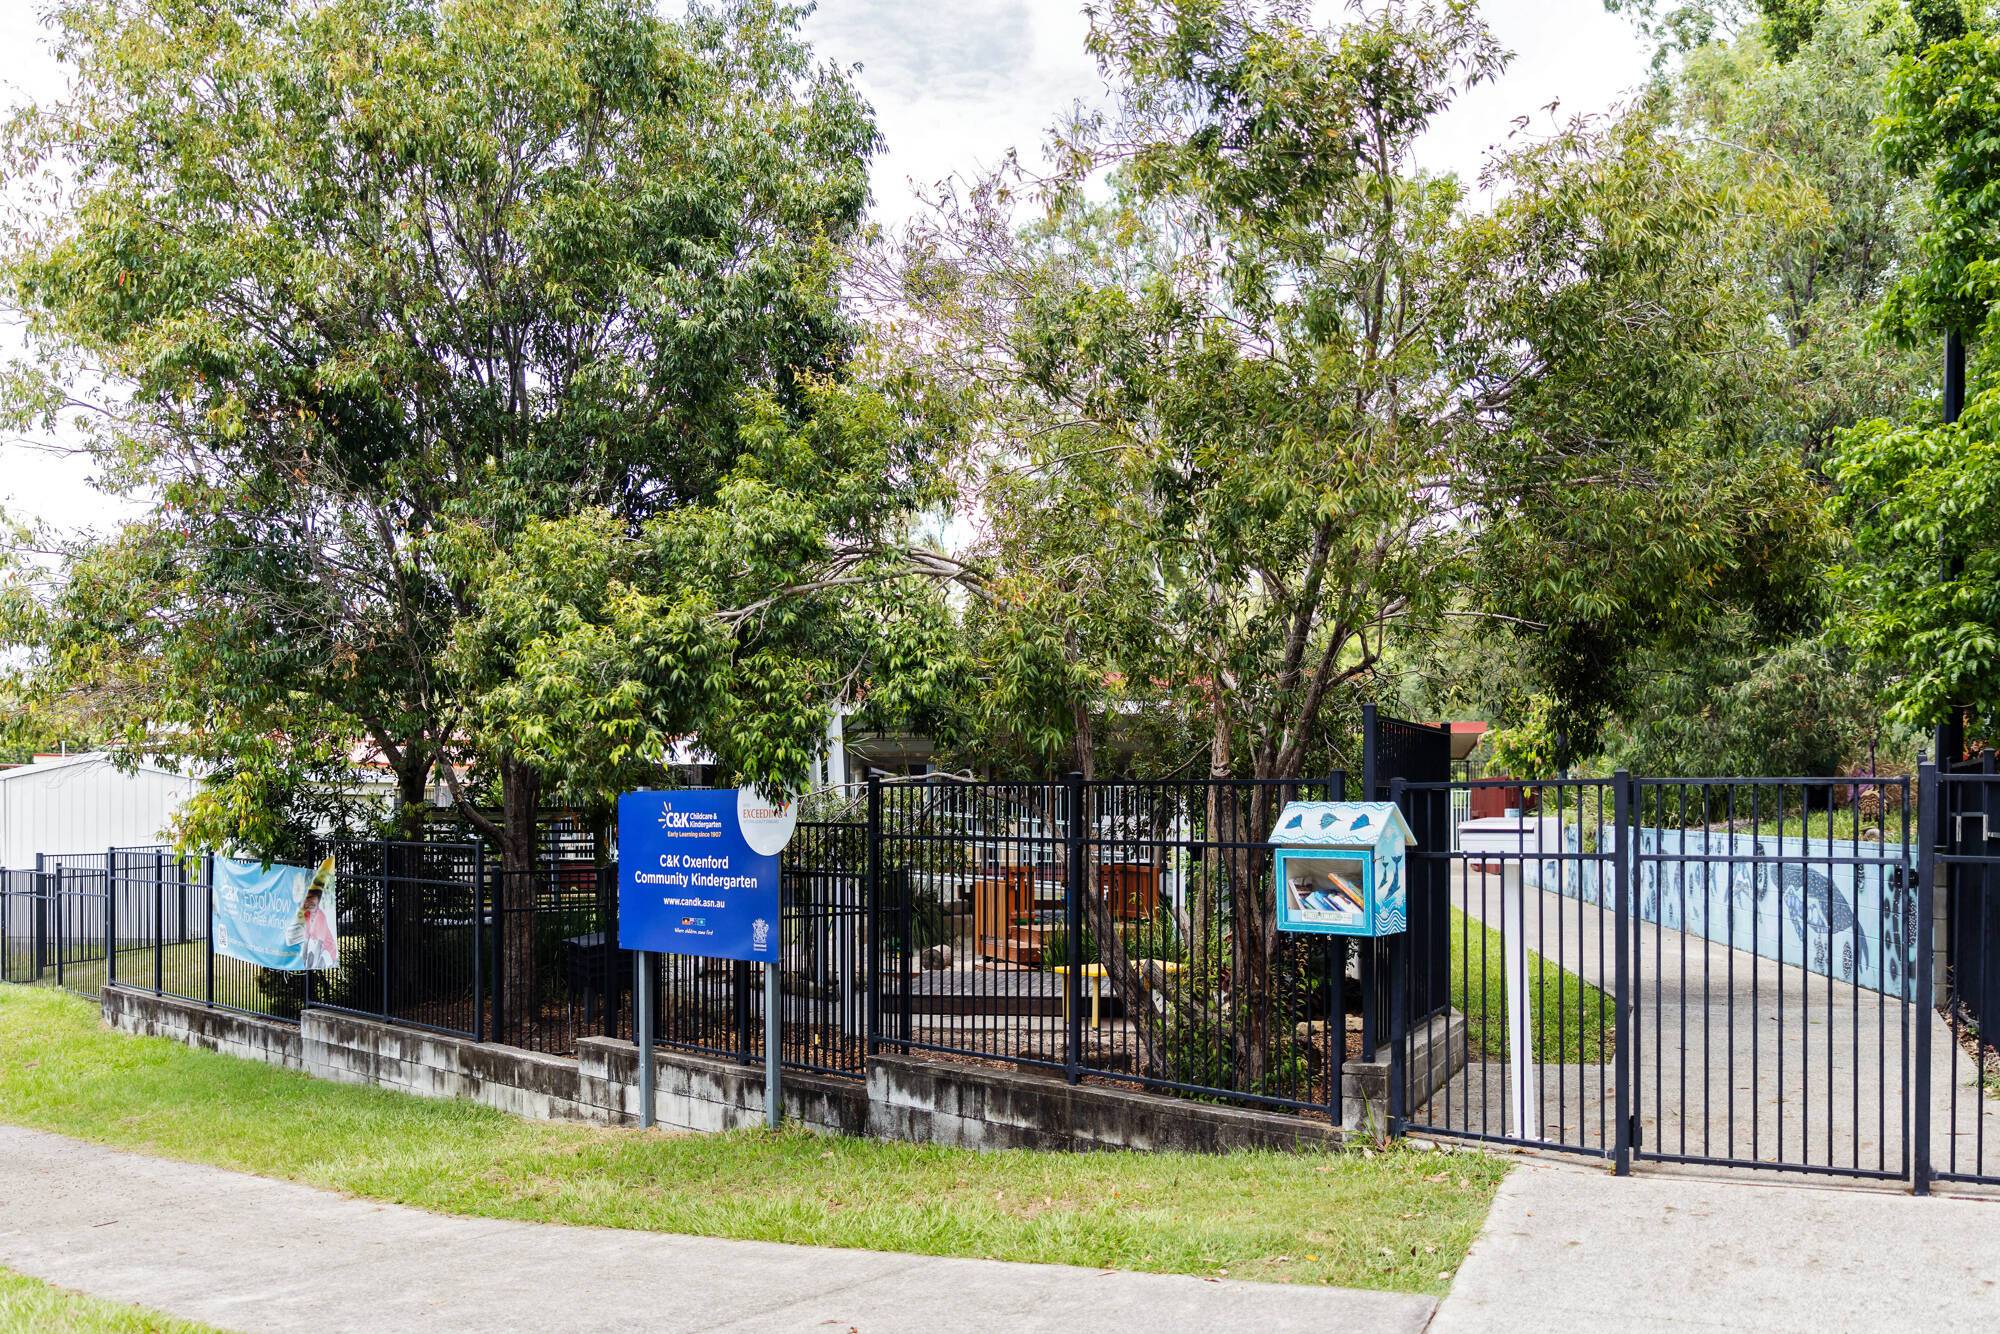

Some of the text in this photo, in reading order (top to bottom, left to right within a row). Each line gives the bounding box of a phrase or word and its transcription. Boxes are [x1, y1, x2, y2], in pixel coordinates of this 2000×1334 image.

[666, 812, 690, 828] C&K
[690, 812, 718, 820] Childcare &
[689, 820, 722, 829] Kindergarten
[667, 831, 678, 839] Early
[678, 831, 698, 839] Learning
[659, 854, 729, 869] C&K Oxenford
[634, 871, 758, 889] Community Kindergarten
[268, 892, 291, 913] Now
[663, 896, 725, 908] www.candk.asn.au
